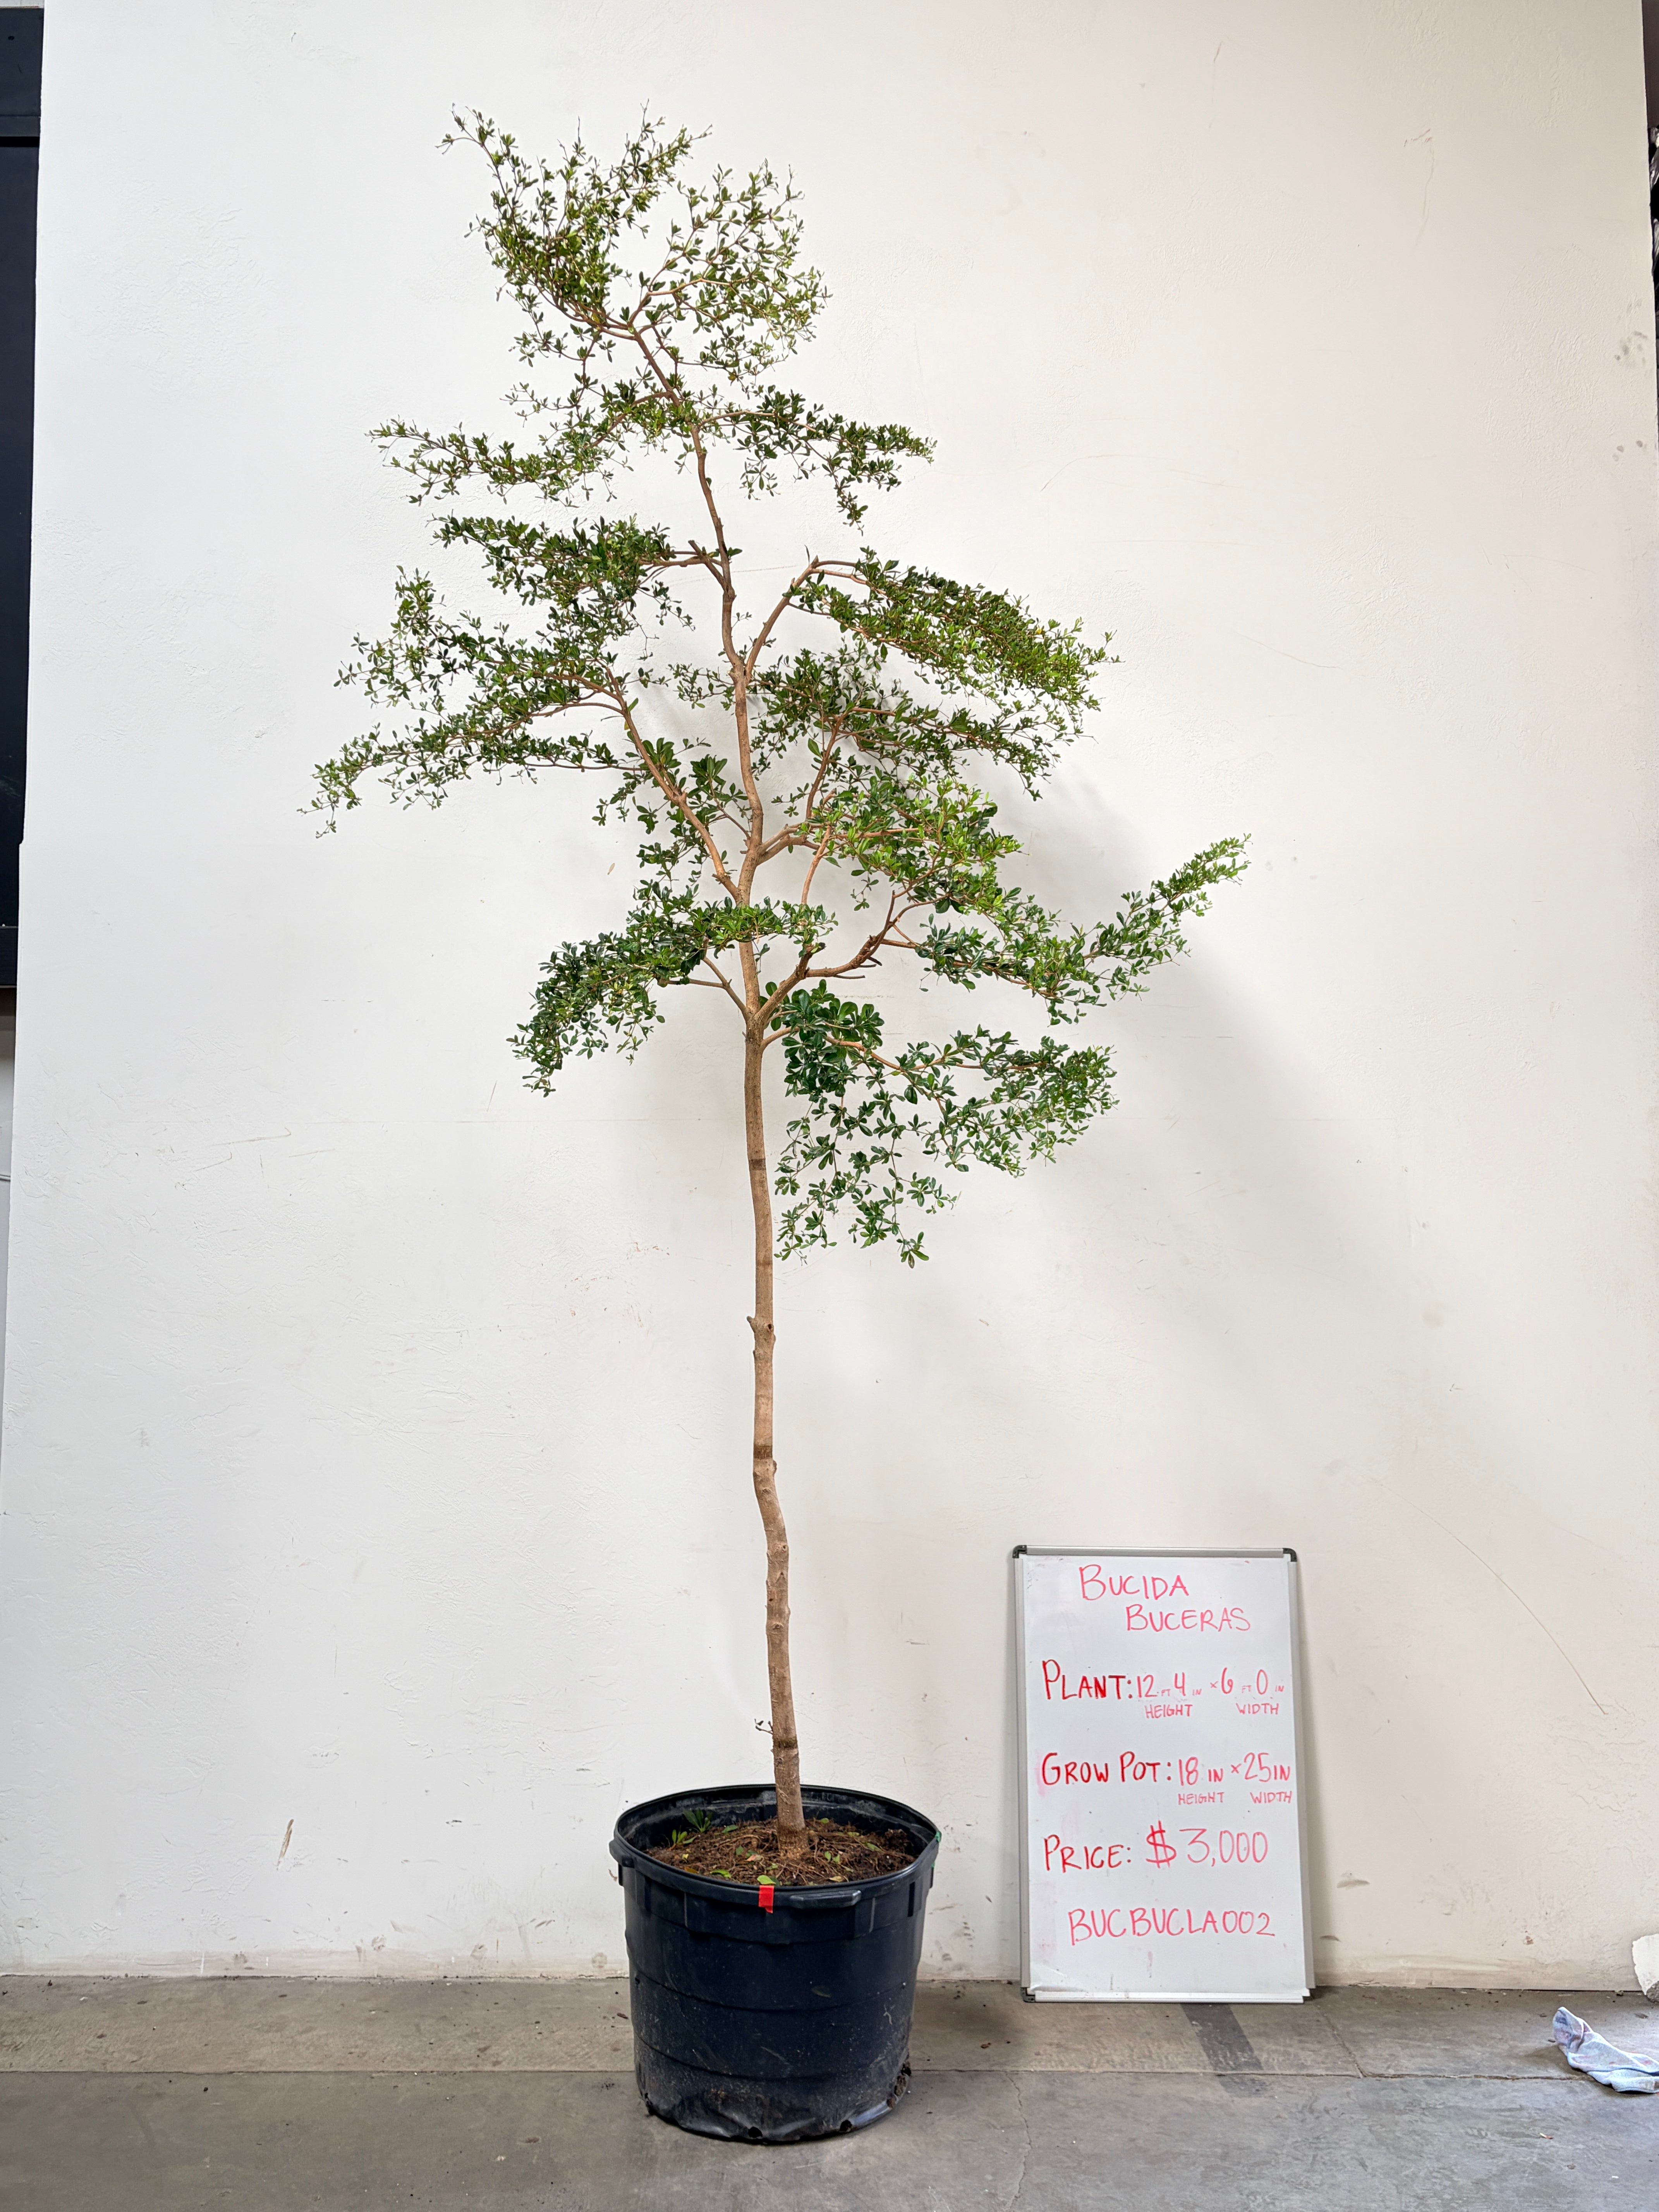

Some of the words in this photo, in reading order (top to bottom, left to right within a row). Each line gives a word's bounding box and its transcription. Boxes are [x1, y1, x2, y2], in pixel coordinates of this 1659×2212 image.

[1079, 1565, 1188, 1601] BUCIDA
[1126, 1604, 1250, 1632] BUCERAS
[1042, 1659, 1132, 1700] PLANT:
[1144, 1704, 1193, 1719] HEIGHT
[1236, 1703, 1279, 1715] WIDTH
[1041, 1752, 1109, 1785] GROW
[1119, 1751, 1171, 1783] POT:
[1178, 1757, 1199, 1786] 18
[1178, 1792, 1224, 1805] HEIGHT
[1250, 1791, 1292, 1804] WIDTH
[1044, 1834, 1131, 1873] PRICE:
